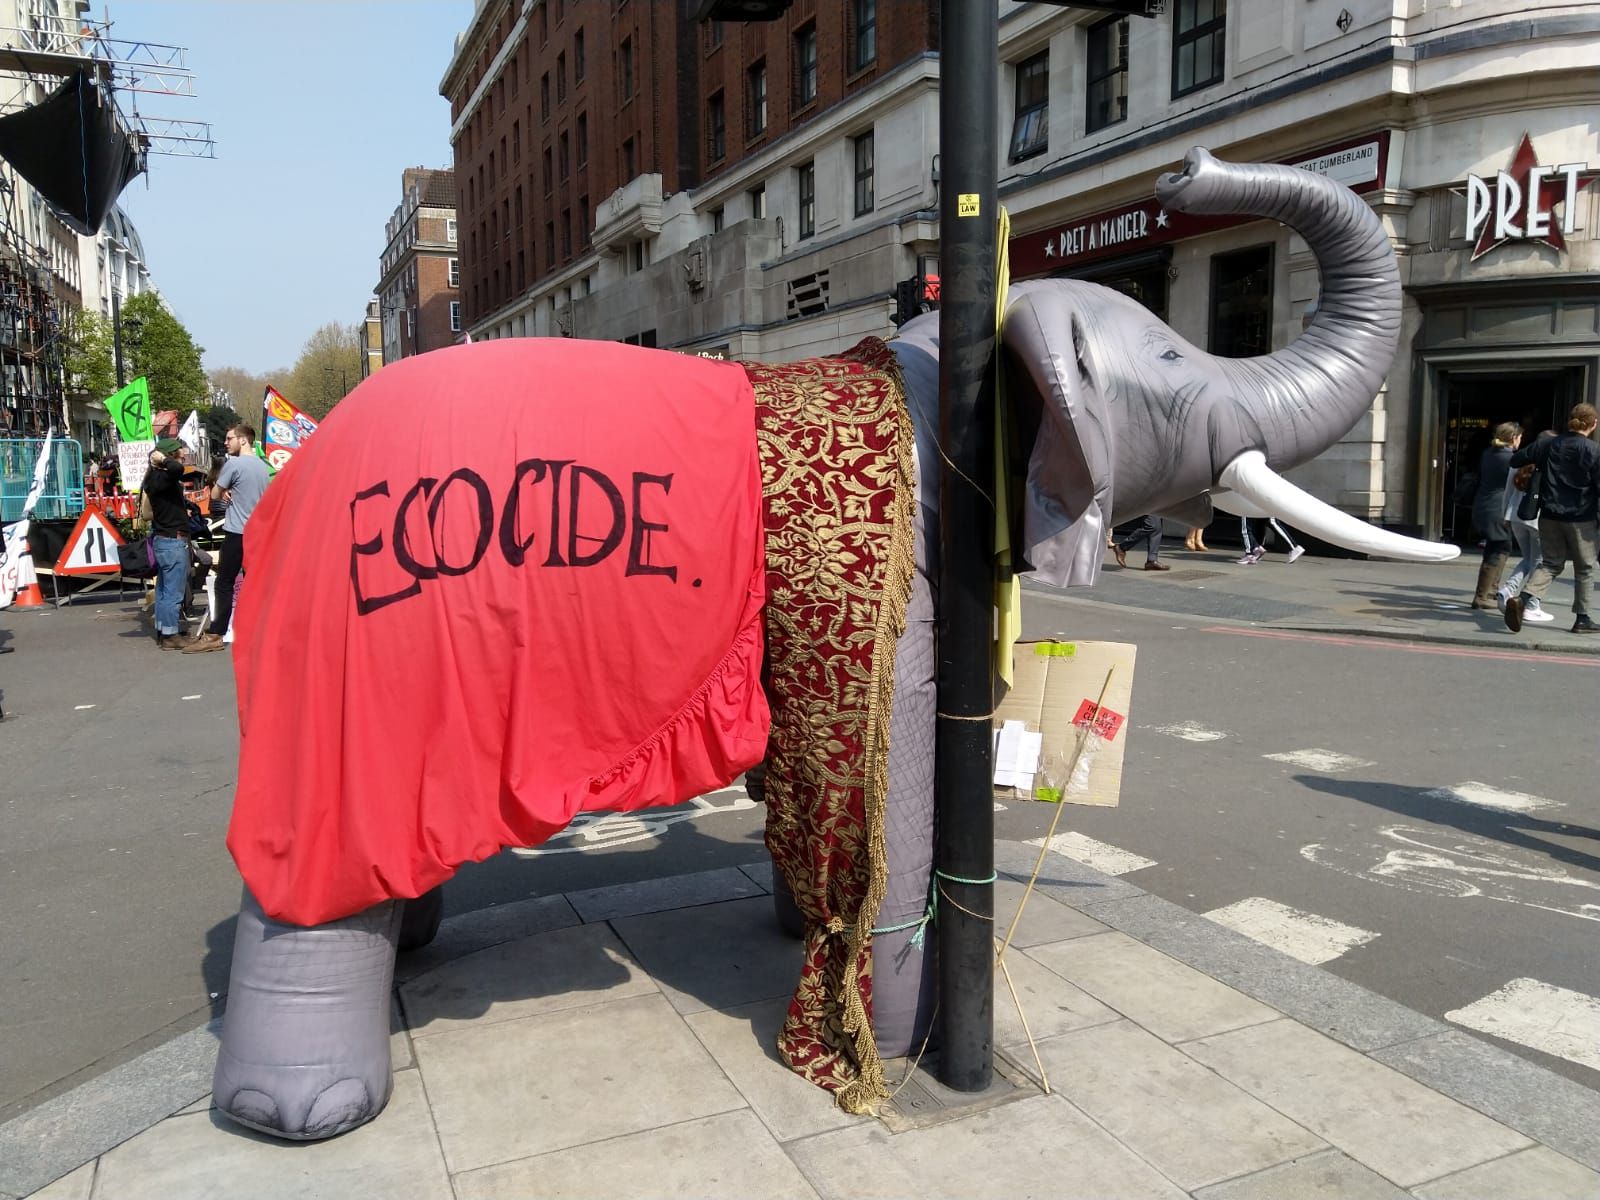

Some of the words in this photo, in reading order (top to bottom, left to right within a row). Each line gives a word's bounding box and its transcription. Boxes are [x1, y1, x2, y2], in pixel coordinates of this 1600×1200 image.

[1319, 147, 1373, 170] CUMBERLAND
[961, 205, 976, 213] LAW
[1465, 162, 1588, 241] PRET
[1060, 225, 1086, 257] PRET
[1088, 223, 1096, 250] A
[1100, 210, 1148, 247] MANGER
[120, 443, 151, 453] DAVID
[350, 458, 702, 616] ECOCIDE.
